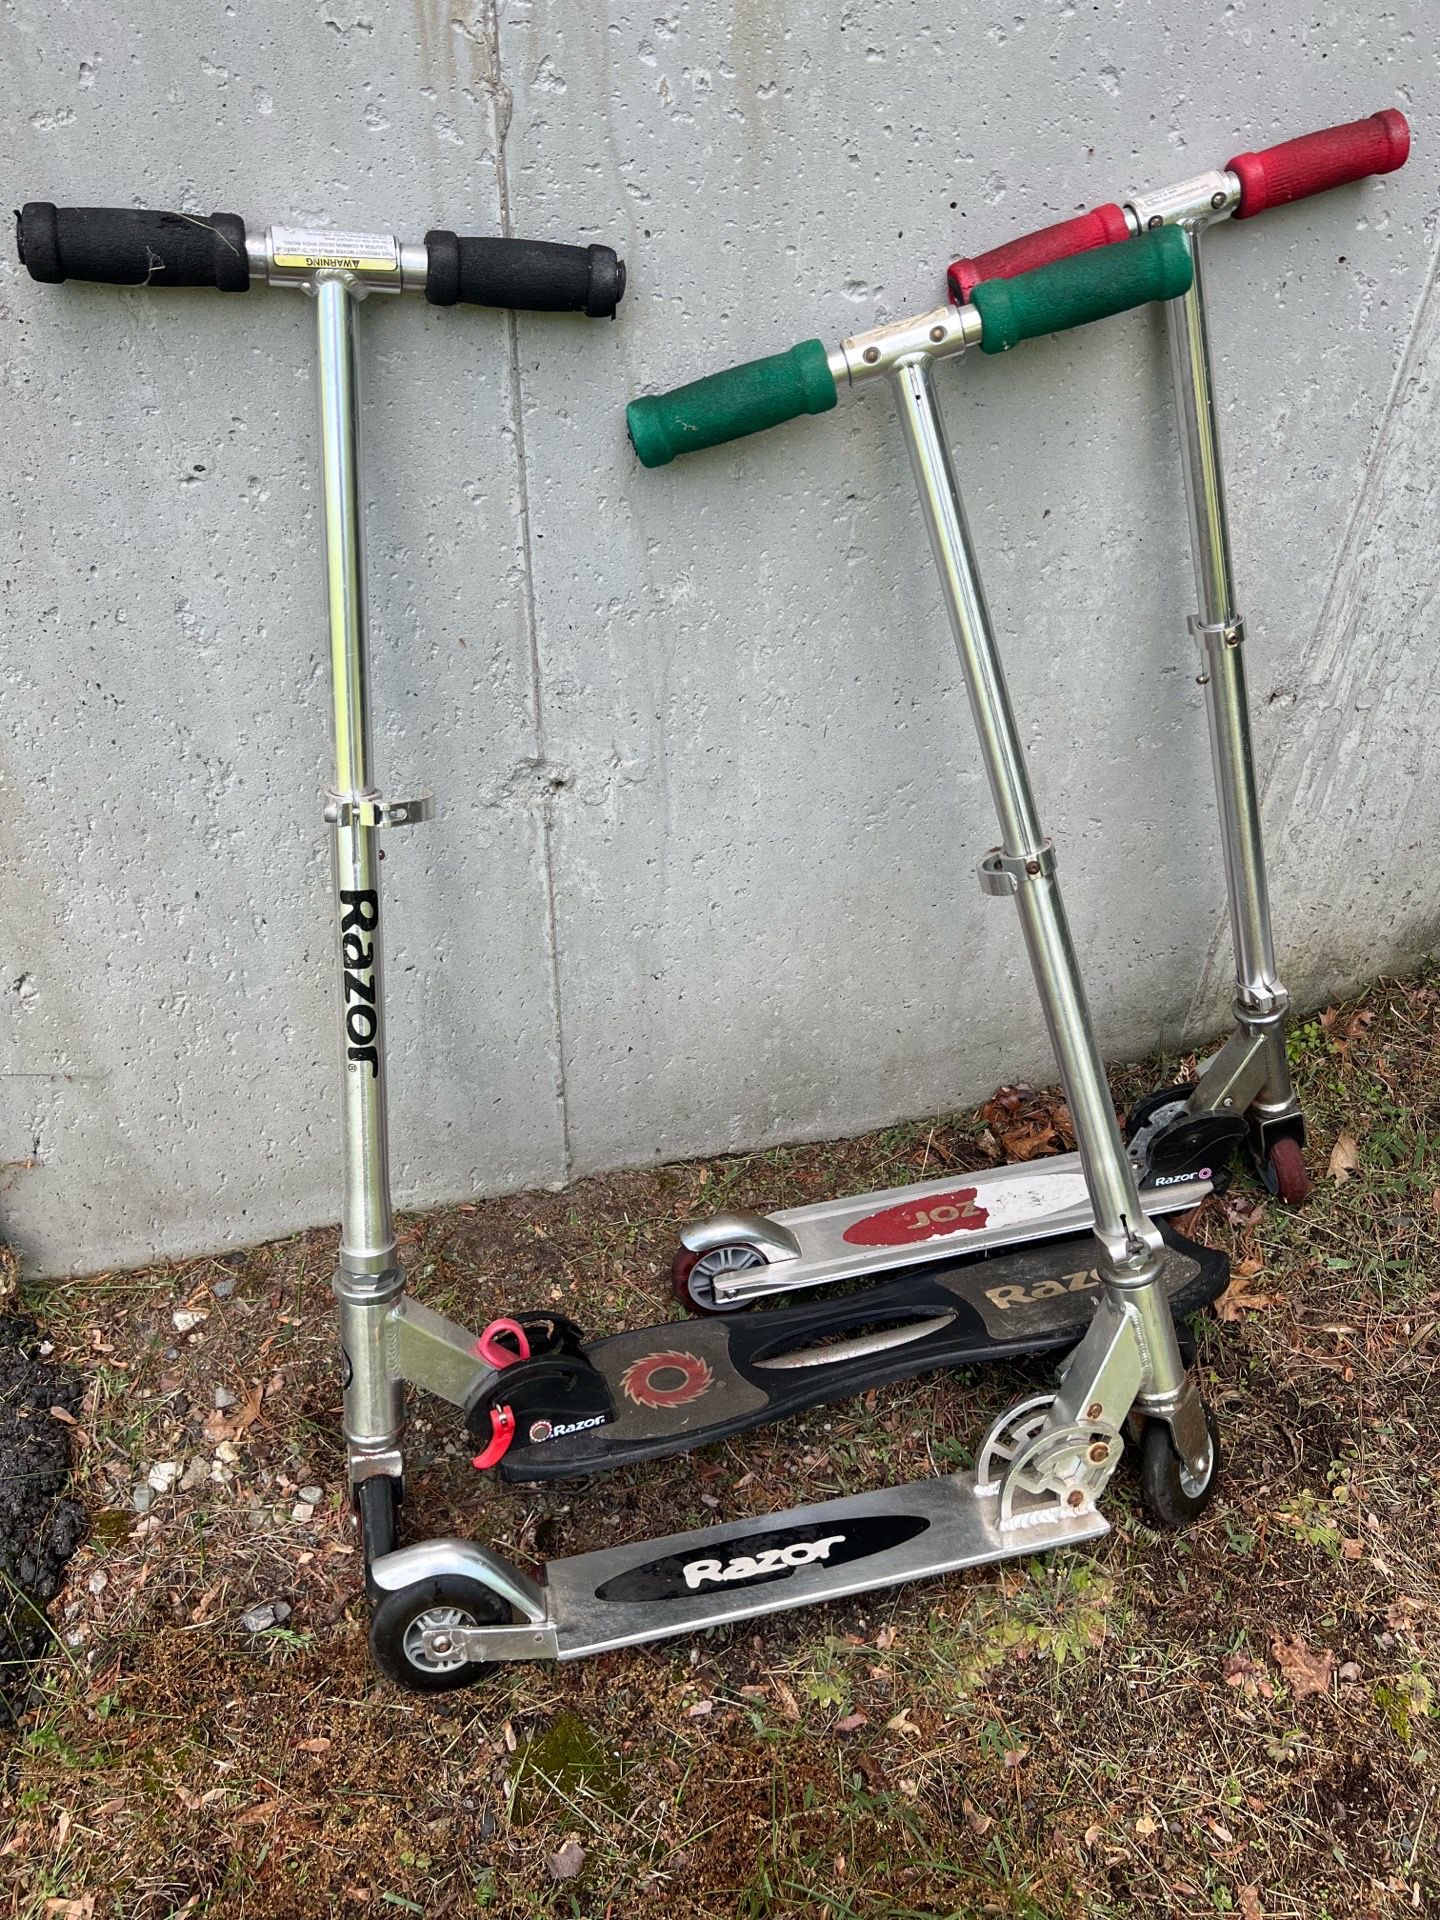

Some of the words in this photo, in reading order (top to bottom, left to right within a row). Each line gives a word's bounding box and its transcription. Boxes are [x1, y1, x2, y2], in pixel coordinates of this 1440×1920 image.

[306, 257, 353, 267] WARNING
[340, 889, 379, 1079] Razor
[1155, 1171, 1199, 1187] Razor
[907, 1200, 982, 1229] zor
[984, 1267, 1101, 1309] Raz
[553, 1415, 605, 1437] Razor
[682, 1535, 847, 1589] Razor
